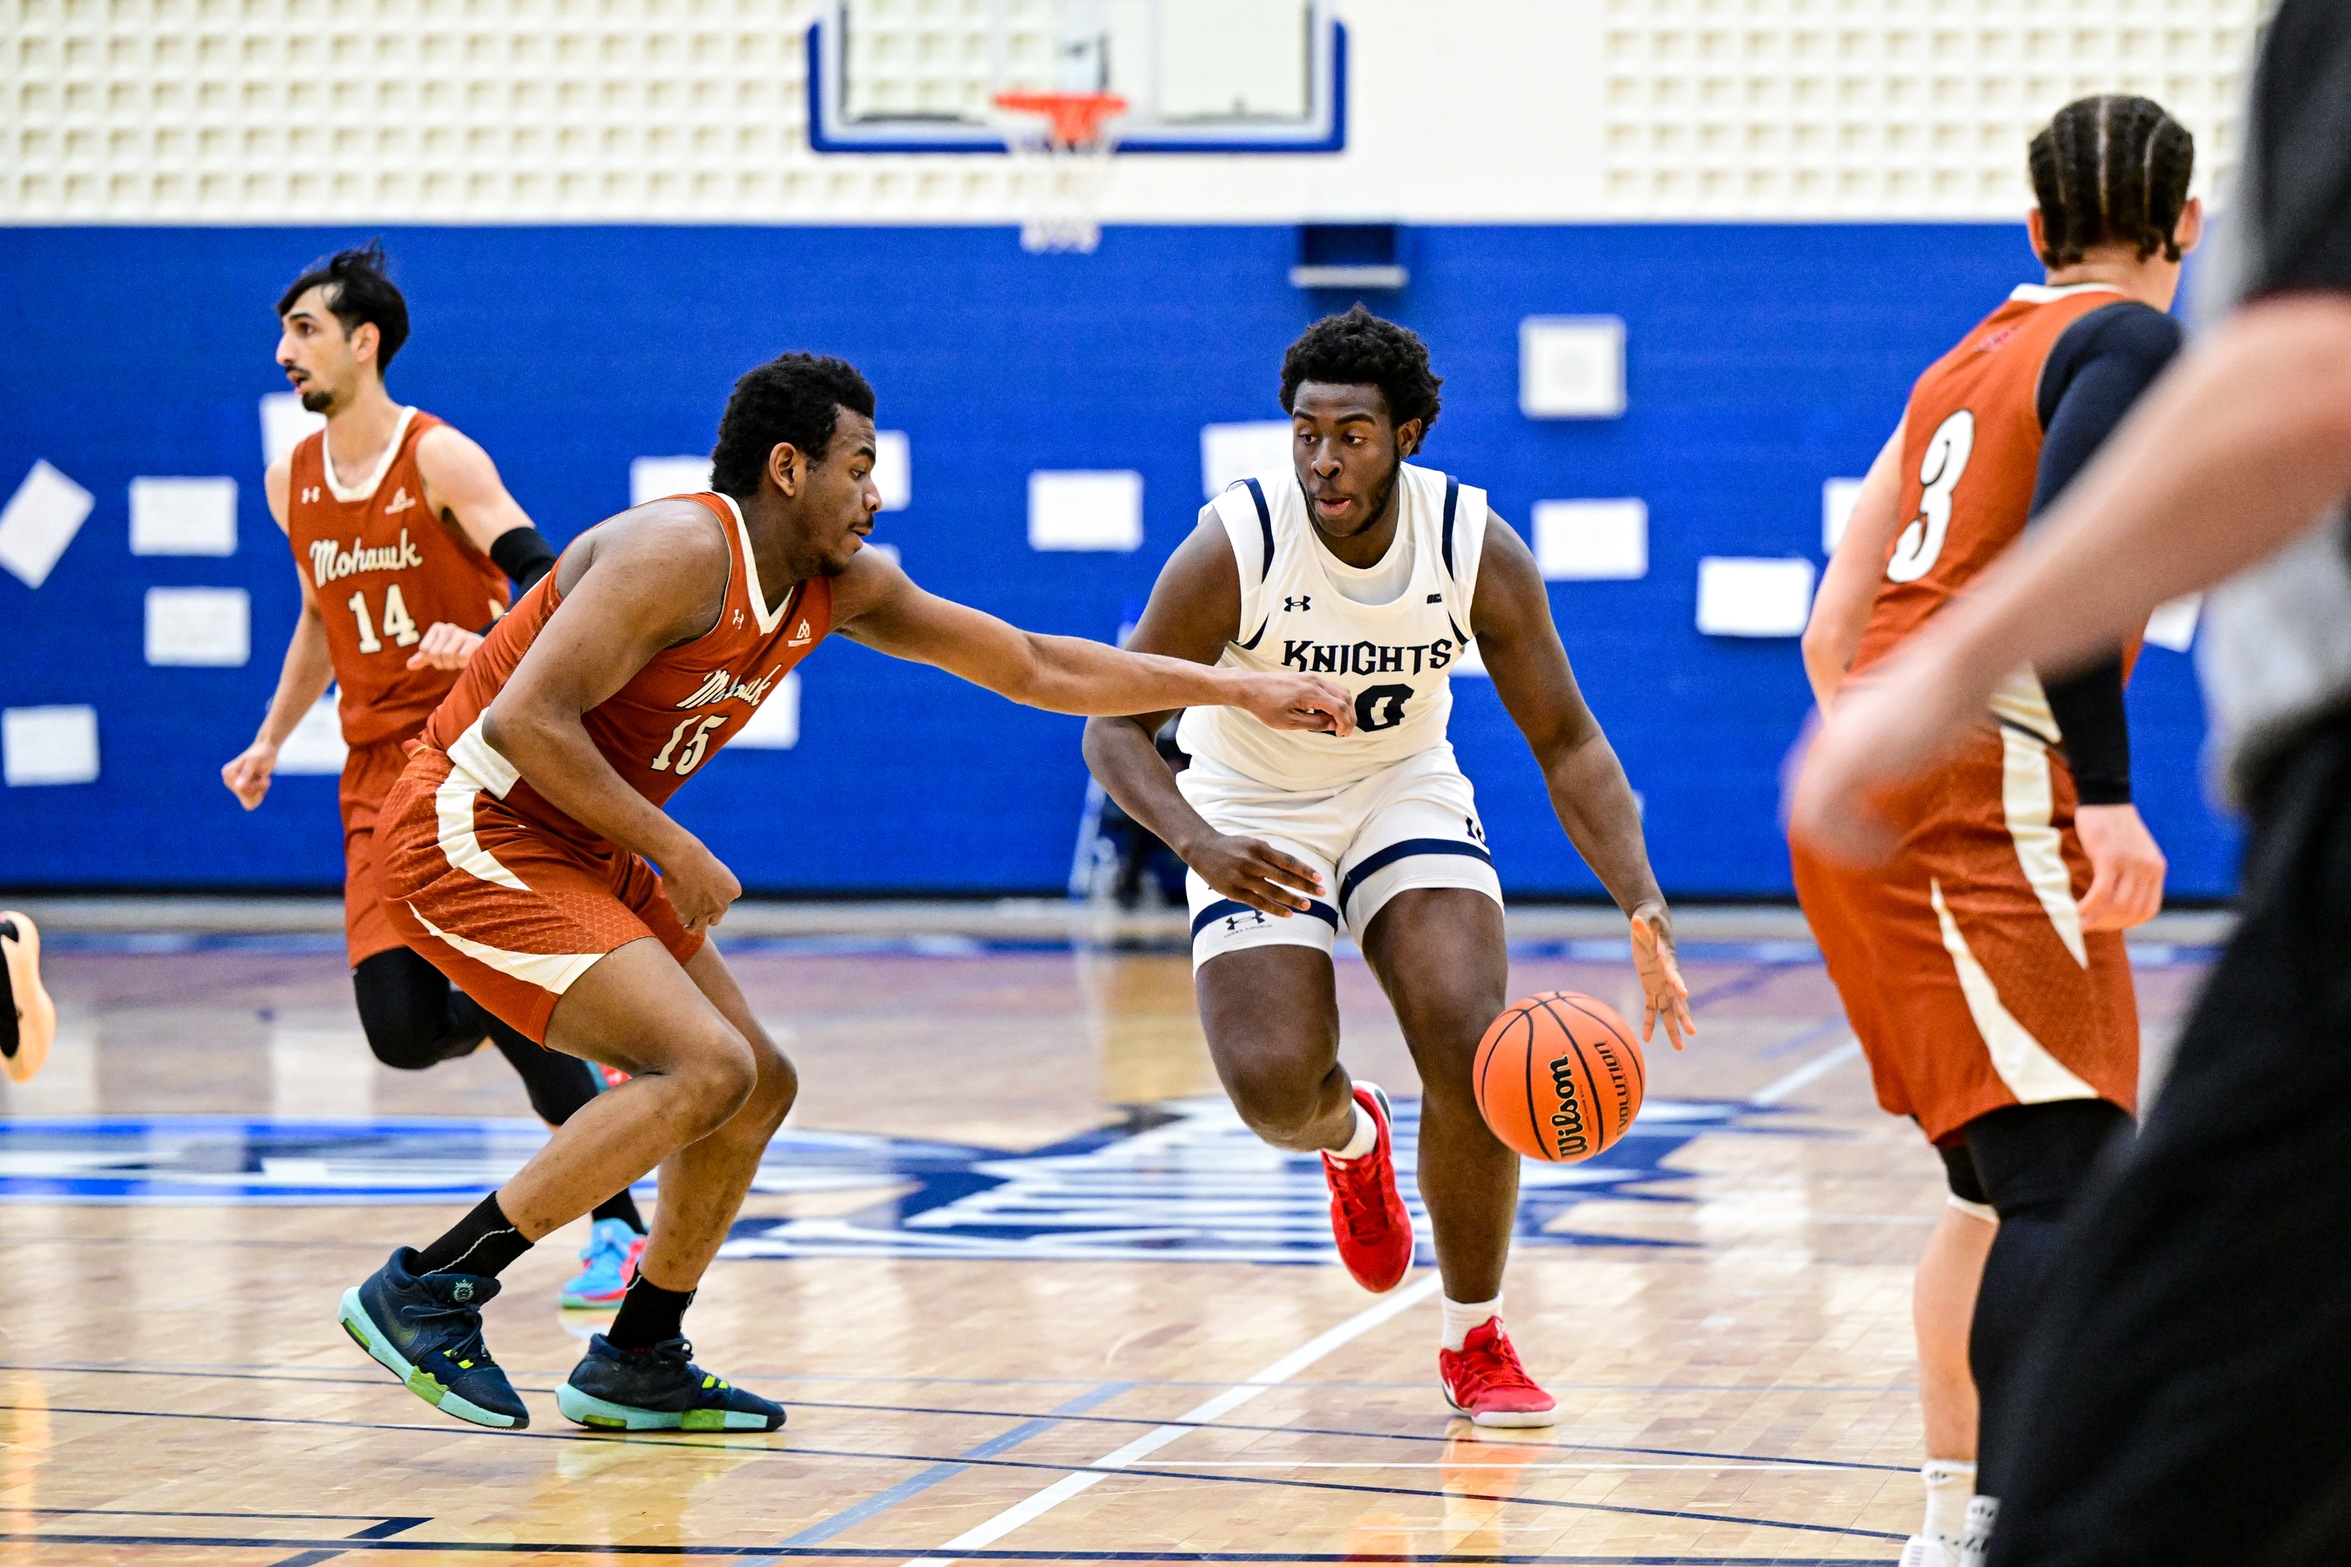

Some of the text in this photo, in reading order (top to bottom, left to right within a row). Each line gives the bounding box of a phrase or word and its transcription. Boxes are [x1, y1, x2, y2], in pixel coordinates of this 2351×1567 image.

[1886, 408, 1975, 584] 3
[309, 528, 424, 589] Mohawk
[348, 583, 421, 655] 14
[1281, 638, 1453, 676] KNIGHTS
[650, 713, 730, 777] 15
[1549, 1053, 1589, 1160] Wilson
